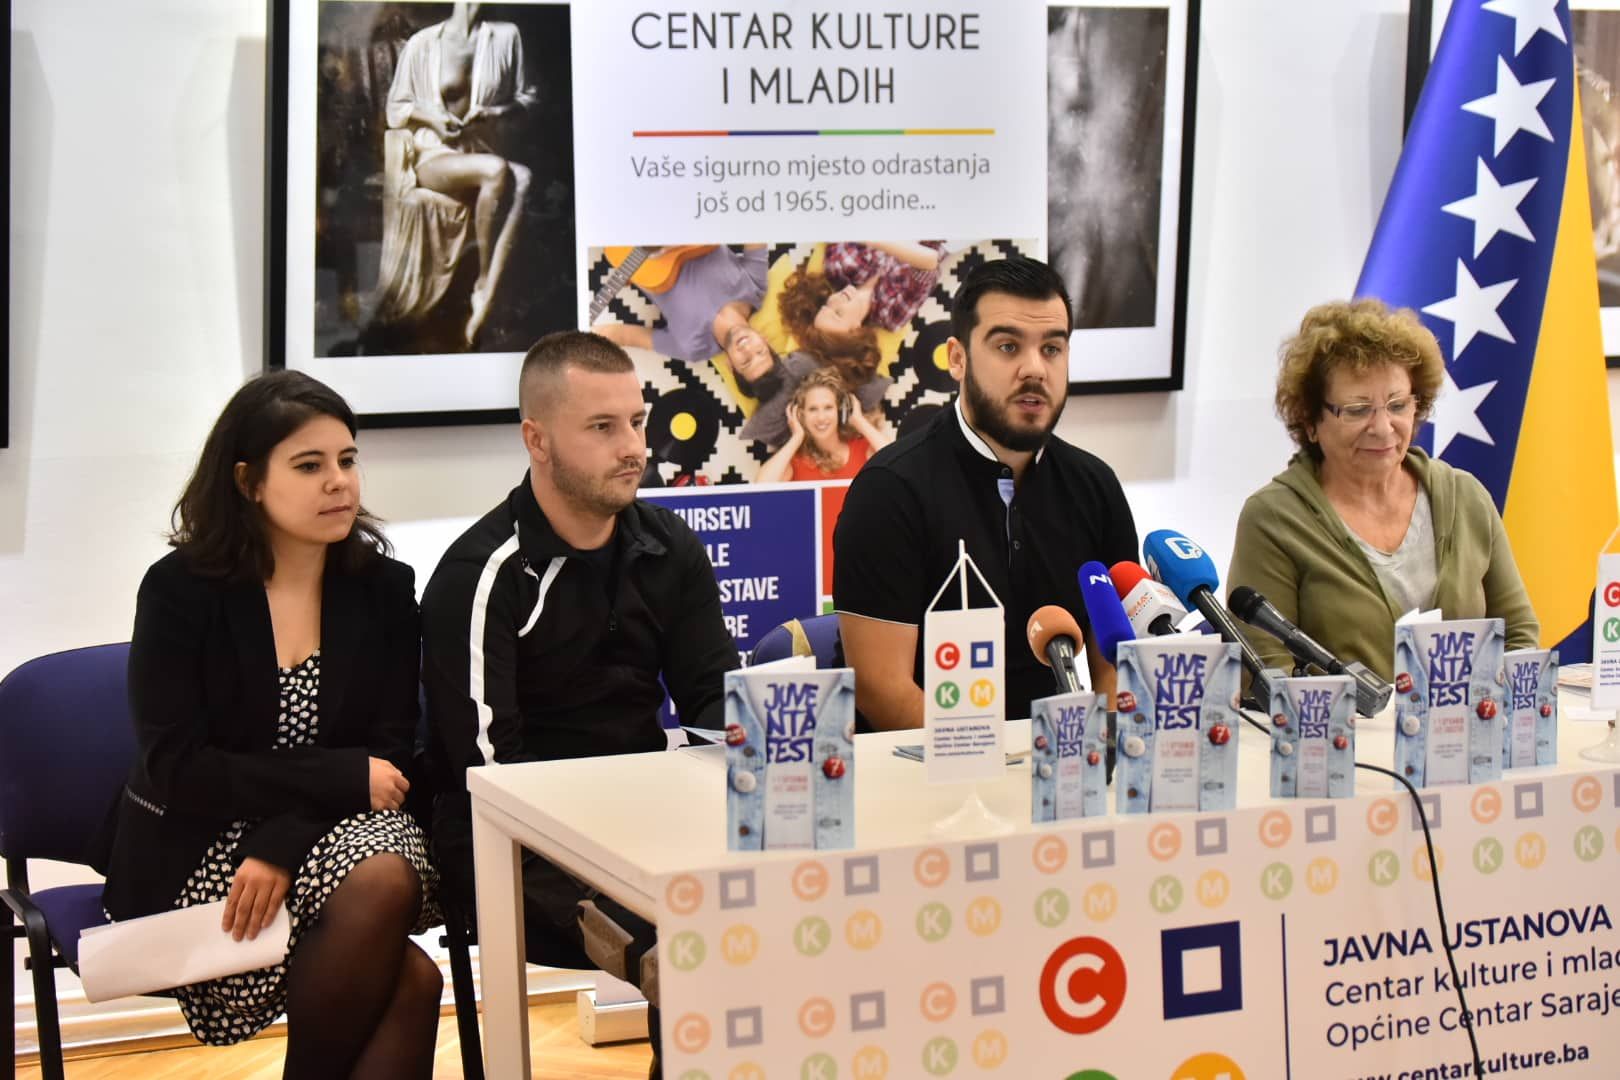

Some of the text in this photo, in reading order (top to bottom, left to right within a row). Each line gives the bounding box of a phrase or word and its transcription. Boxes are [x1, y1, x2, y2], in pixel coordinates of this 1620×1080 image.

[631, 12, 980, 49] CENTAR KULTURE
[723, 67, 895, 104] I MLADIH
[631, 153, 991, 182] Vaše sigurno mjesto odrastanja
[694, 188, 937, 219] još od 1965. godine...
[705, 543, 730, 567] LE
[717, 576, 779, 603] STAVE
[1607, 621, 1619, 639] K
[940, 647, 955, 666] C
[941, 685, 991, 704] K M
[1429, 682, 1470, 707] FEST
[1155, 705, 1201, 730] FEST
[766, 738, 813, 763] FEST
[1323, 904, 1612, 966] JAVNA USTANOVA
[1054, 953, 1106, 1018] C
[1326, 976, 1424, 1006] Centar
[1434, 961, 1537, 993] kulture
[1547, 951, 1552, 977] i
[1327, 1013, 1430, 1051] Općine
[1439, 1001, 1533, 1031] Centar
